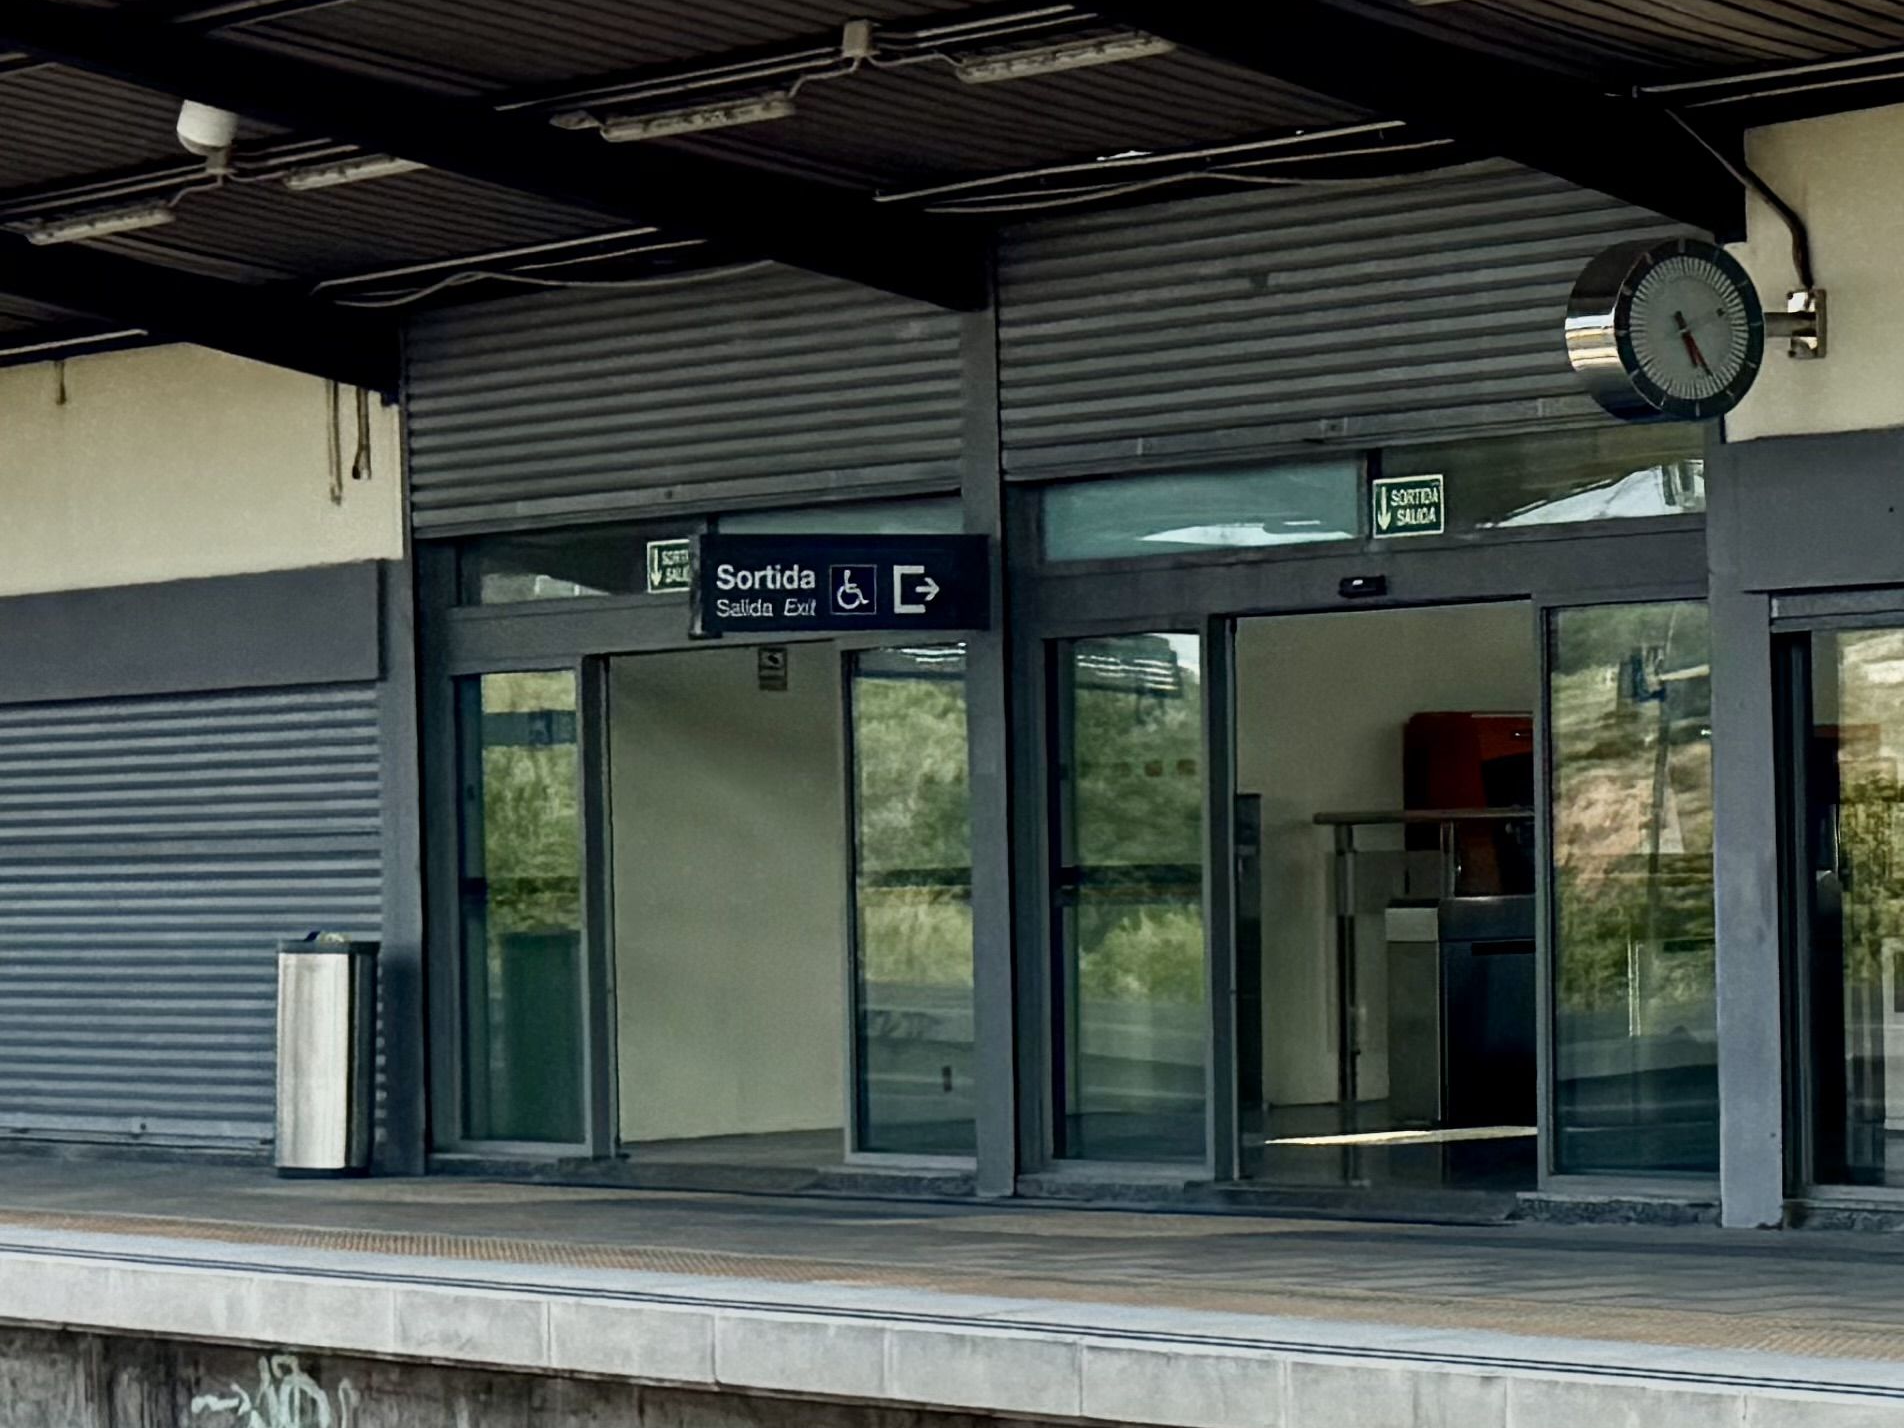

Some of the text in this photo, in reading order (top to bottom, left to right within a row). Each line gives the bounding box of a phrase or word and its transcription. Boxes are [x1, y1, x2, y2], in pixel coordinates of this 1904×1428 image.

[1390, 487, 1439, 507] SORTIDA
[1396, 507, 1437, 526] SALIDA
[716, 563, 817, 590] Sortida
[716, 598, 817, 618] Salida Exit
